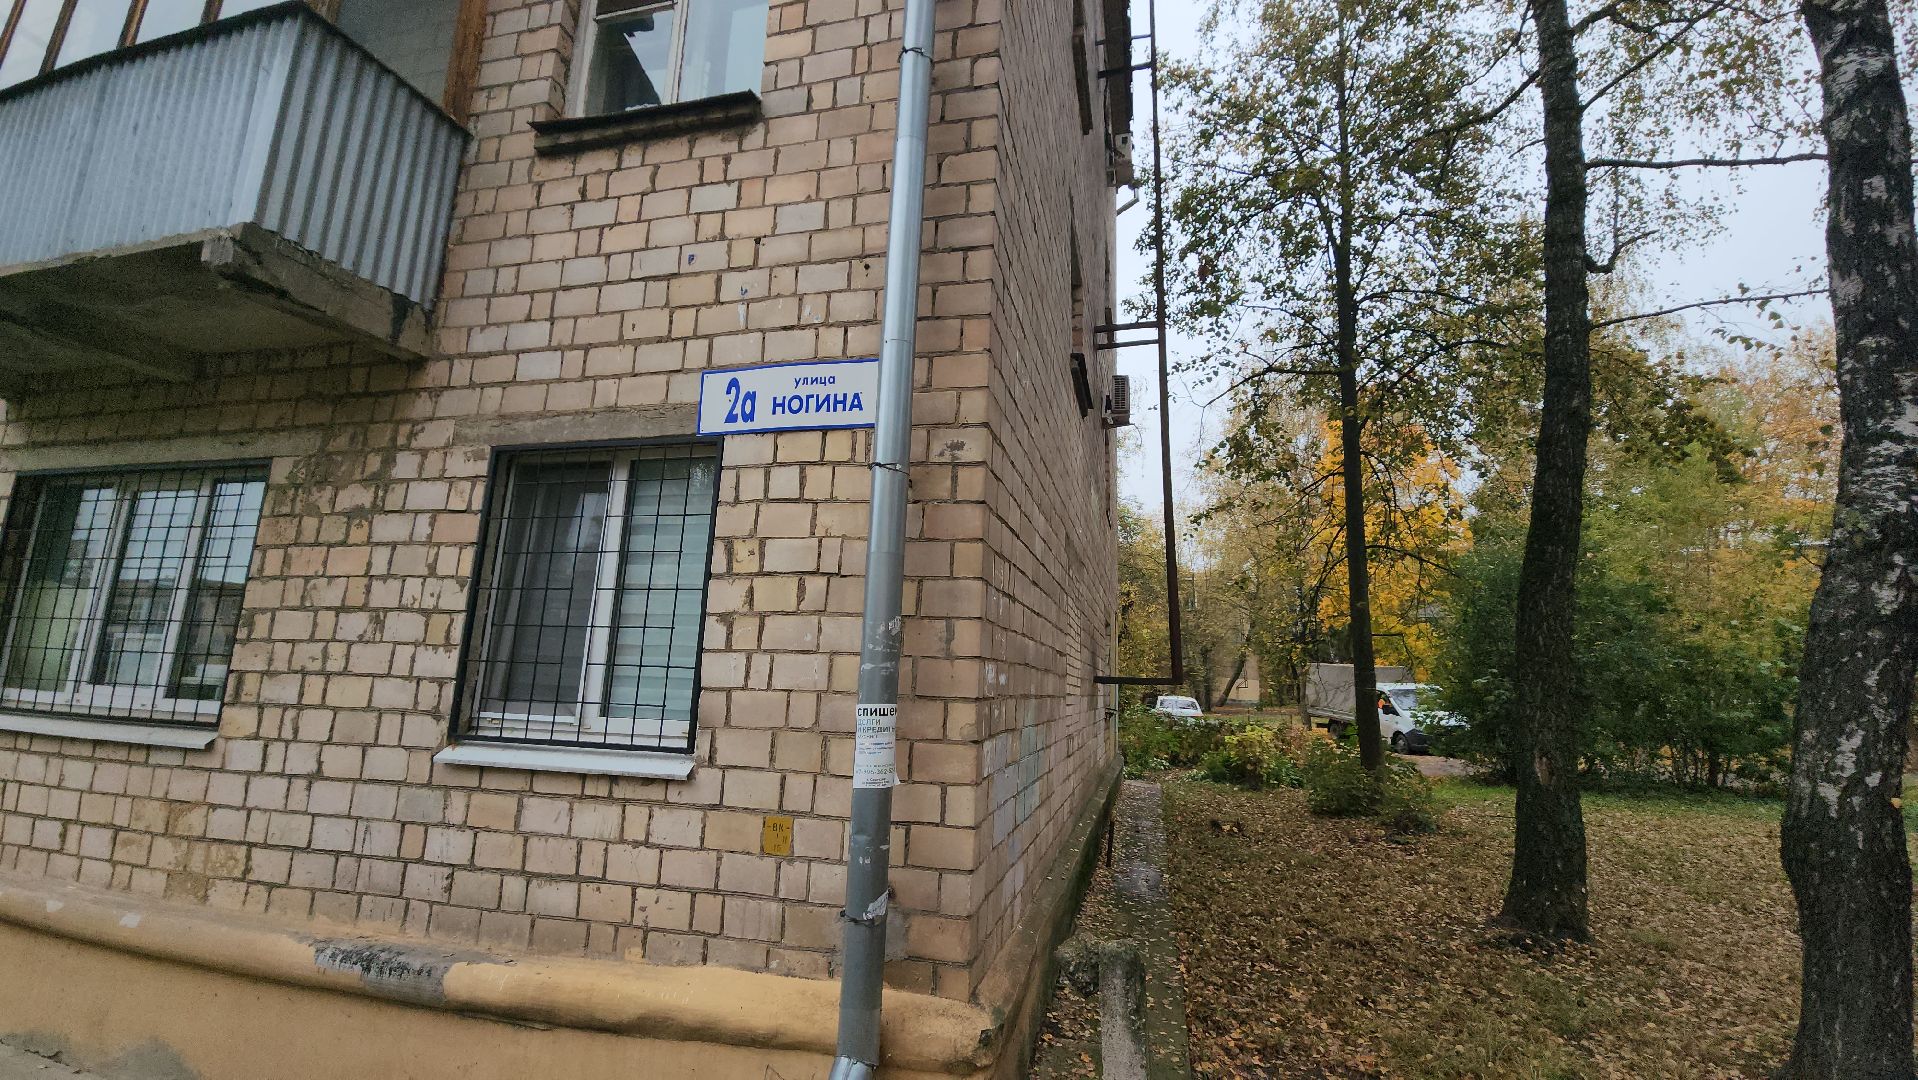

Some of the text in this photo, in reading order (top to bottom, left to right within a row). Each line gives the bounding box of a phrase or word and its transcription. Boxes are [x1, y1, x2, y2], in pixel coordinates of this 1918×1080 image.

[794, 375, 836, 389] улица
[723, 377, 757, 424] 2а
[771, 392, 864, 416] НОГИНА
